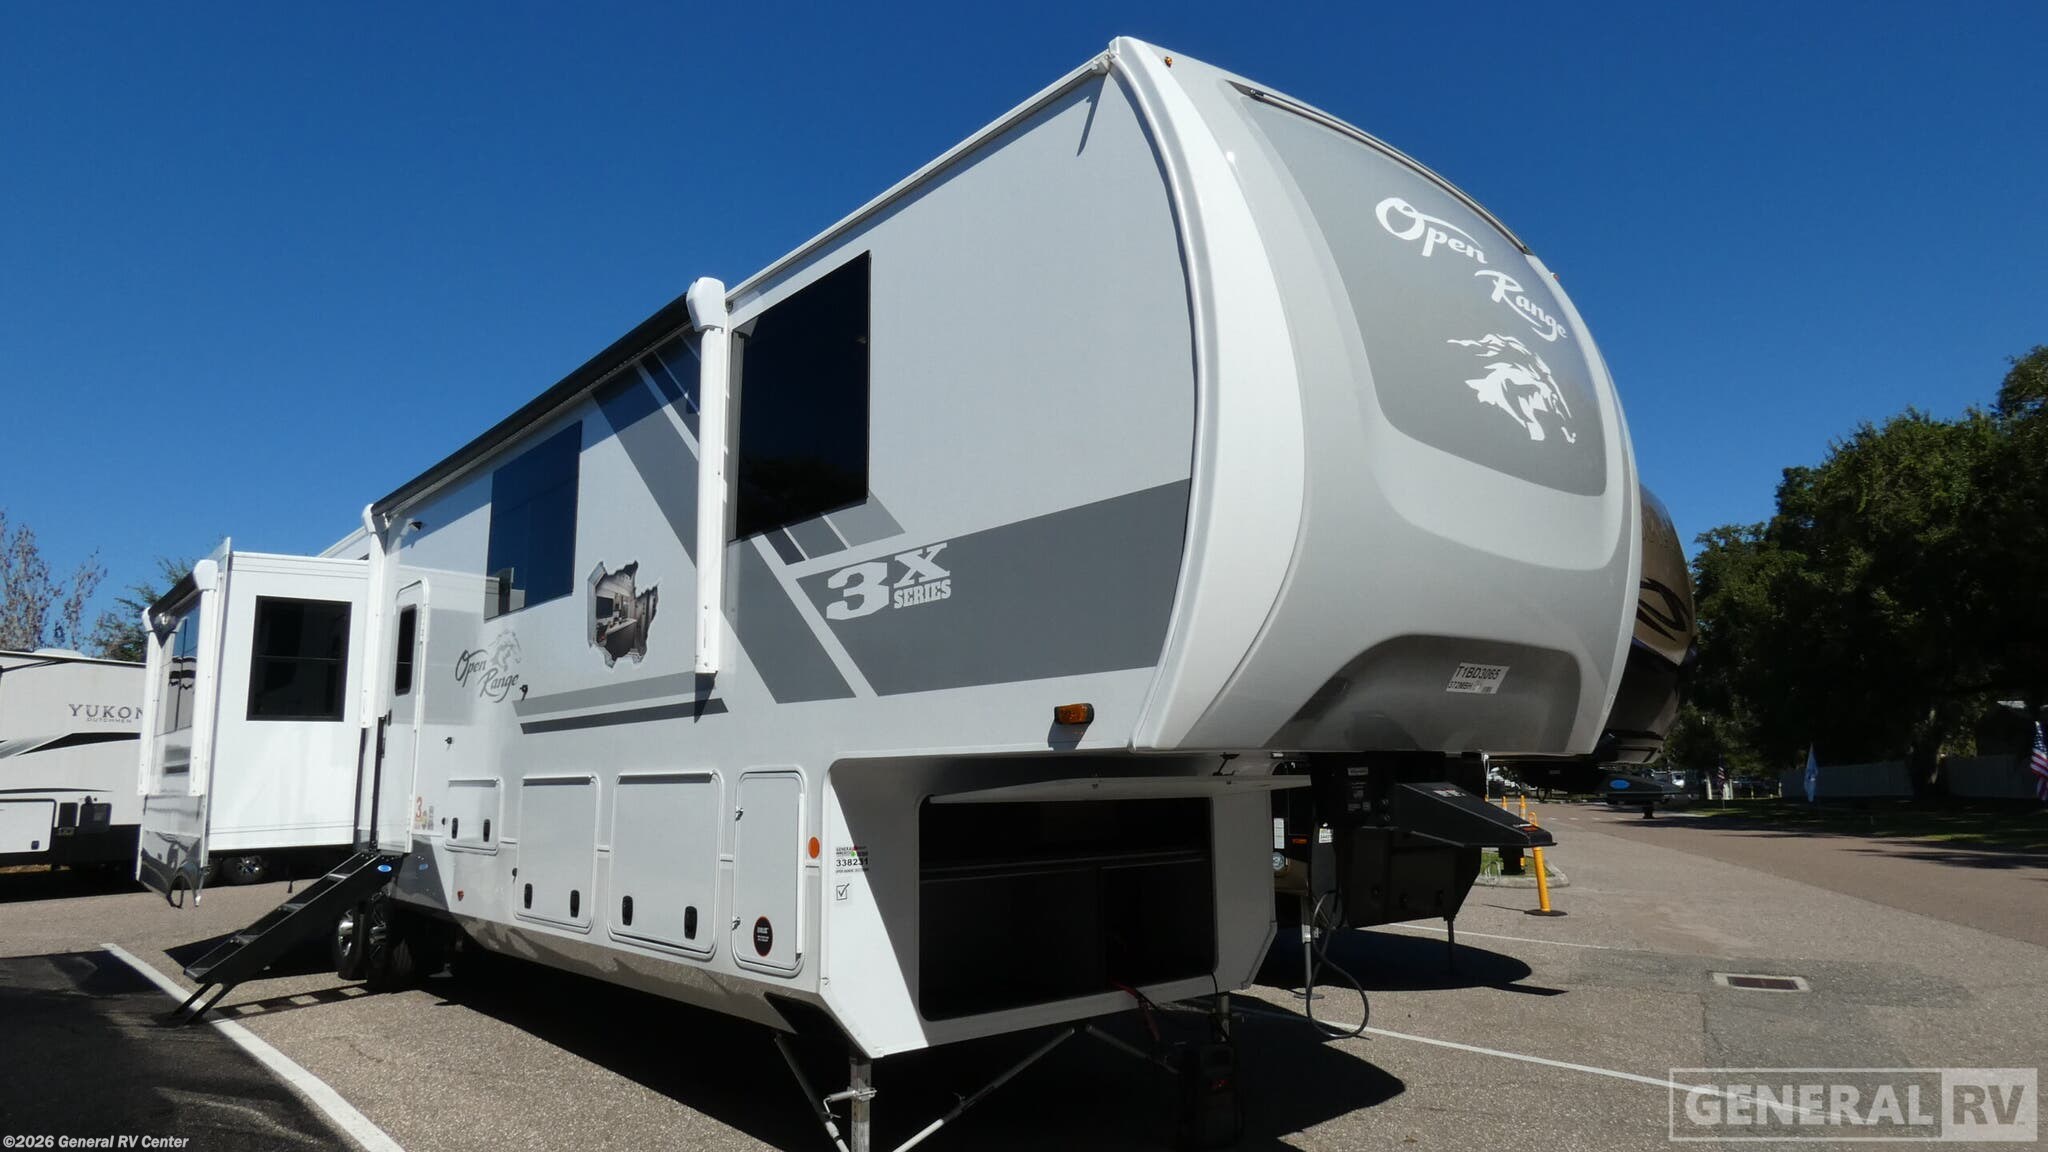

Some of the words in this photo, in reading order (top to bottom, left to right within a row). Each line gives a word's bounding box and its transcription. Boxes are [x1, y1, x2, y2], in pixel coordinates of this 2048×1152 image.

[1376, 197, 1487, 265] Open
[1474, 269, 1567, 342] Range
[893, 579, 952, 609] SERIES
[455, 649, 488, 688] Open
[477, 667, 519, 703] Range
